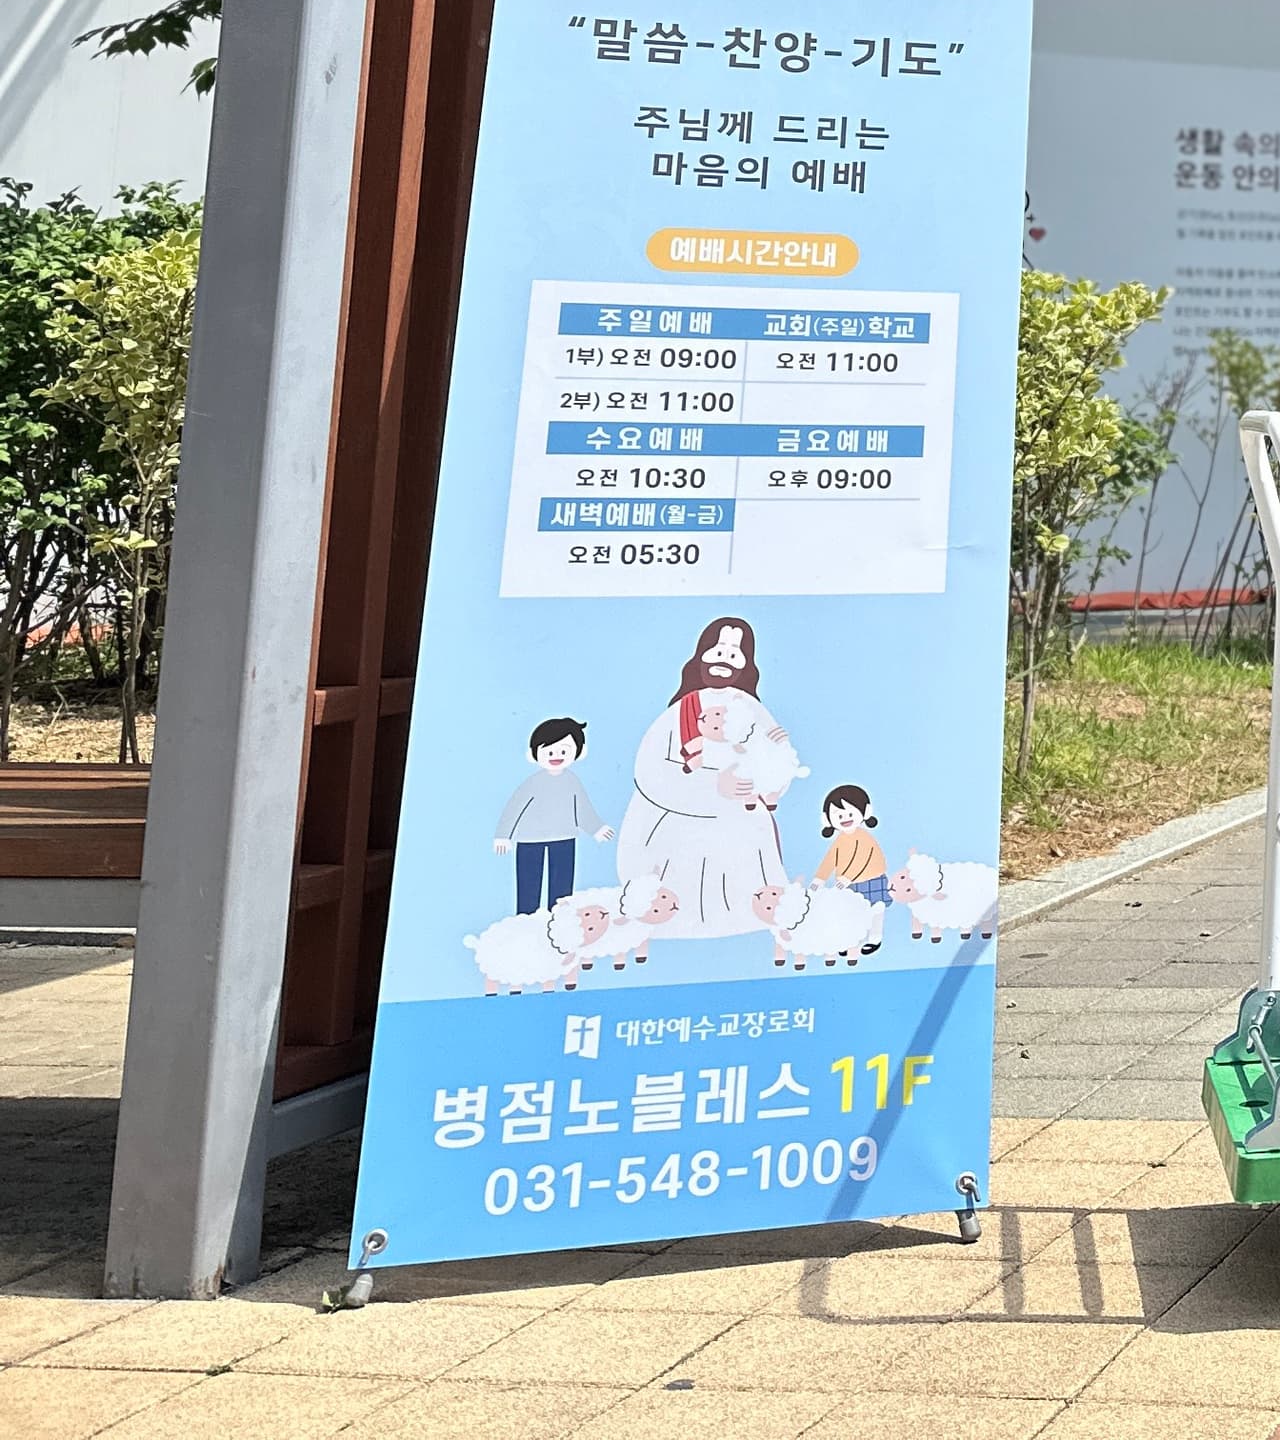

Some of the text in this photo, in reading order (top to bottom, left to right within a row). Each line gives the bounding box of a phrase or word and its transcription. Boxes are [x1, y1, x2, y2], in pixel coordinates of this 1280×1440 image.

[634, 107, 890, 151] 주님께 드리는
[1176, 128, 1223, 157] 생활
[1233, 132, 1280, 159] 속의
[652, 154, 866, 194] 마음의 예배
[1175, 163, 1223, 190] 운동
[1232, 165, 1280, 192] 안의
[669, 235, 838, 269] 예배시간안내
[597, 309, 712, 335] 주일예배
[566, 348, 736, 369] 1부) 오전 09:00
[776, 352, 898, 372] 오전 11:00
[560, 392, 734, 412] 2부) 오전 11:00
[586, 427, 703, 451] 수요예배
[777, 429, 889, 453] 금요예배
[576, 468, 706, 489] 오전 10:30
[768, 469, 892, 490] 오후 09:00
[568, 544, 700, 565] 오전 05:30
[615, 1007, 816, 1047] 대한예수교장로회
[431, 1055, 935, 1149] 병점노블레스 11F
[484, 1135, 878, 1216] 031-548-1009
